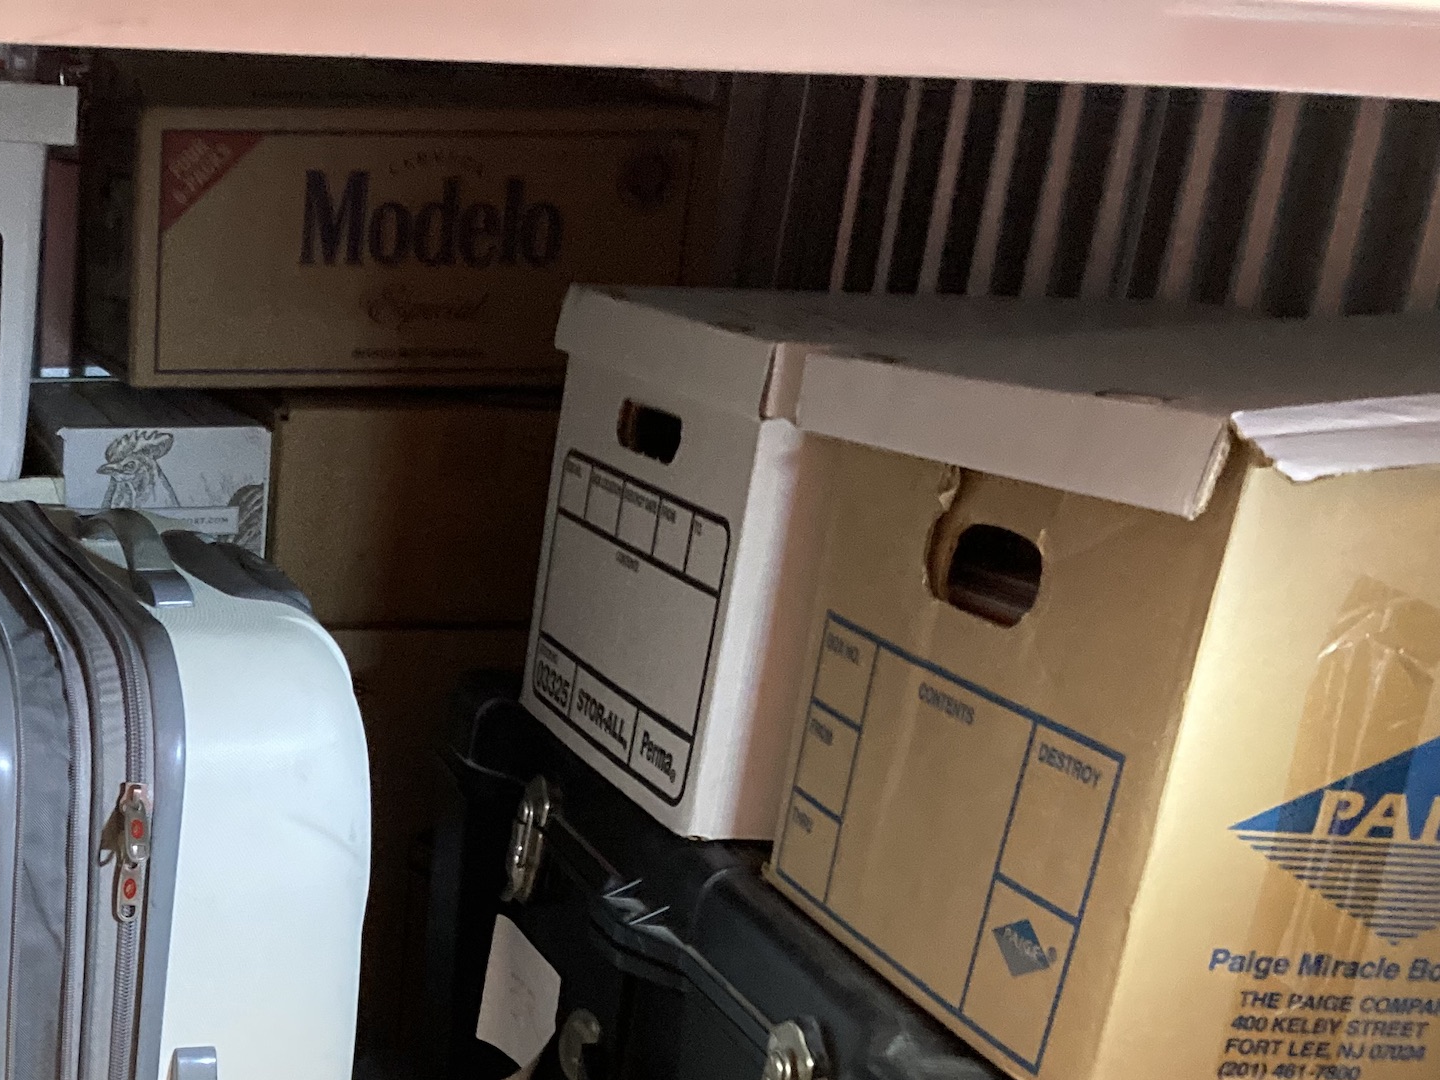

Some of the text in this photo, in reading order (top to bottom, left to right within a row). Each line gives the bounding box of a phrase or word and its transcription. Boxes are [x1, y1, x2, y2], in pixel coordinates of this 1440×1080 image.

[299, 170, 564, 268] Modelo
[918, 682, 974, 725] CONTENTS
[640, 730, 673, 775] Perma
[1038, 742, 1102, 789] DESTROY
[1209, 949, 1290, 980] Paige
[1297, 952, 1401, 980] Miracle
[1241, 990, 1283, 1009] THE
[1286, 992, 1354, 1013] PAIGE
[1231, 1015, 1430, 1039] 400 KELBY STREET
[1225, 1038, 1284, 1055] FORT
[1337, 1043, 1364, 1060] NJ
[1217, 1061, 1267, 1080] (201)
